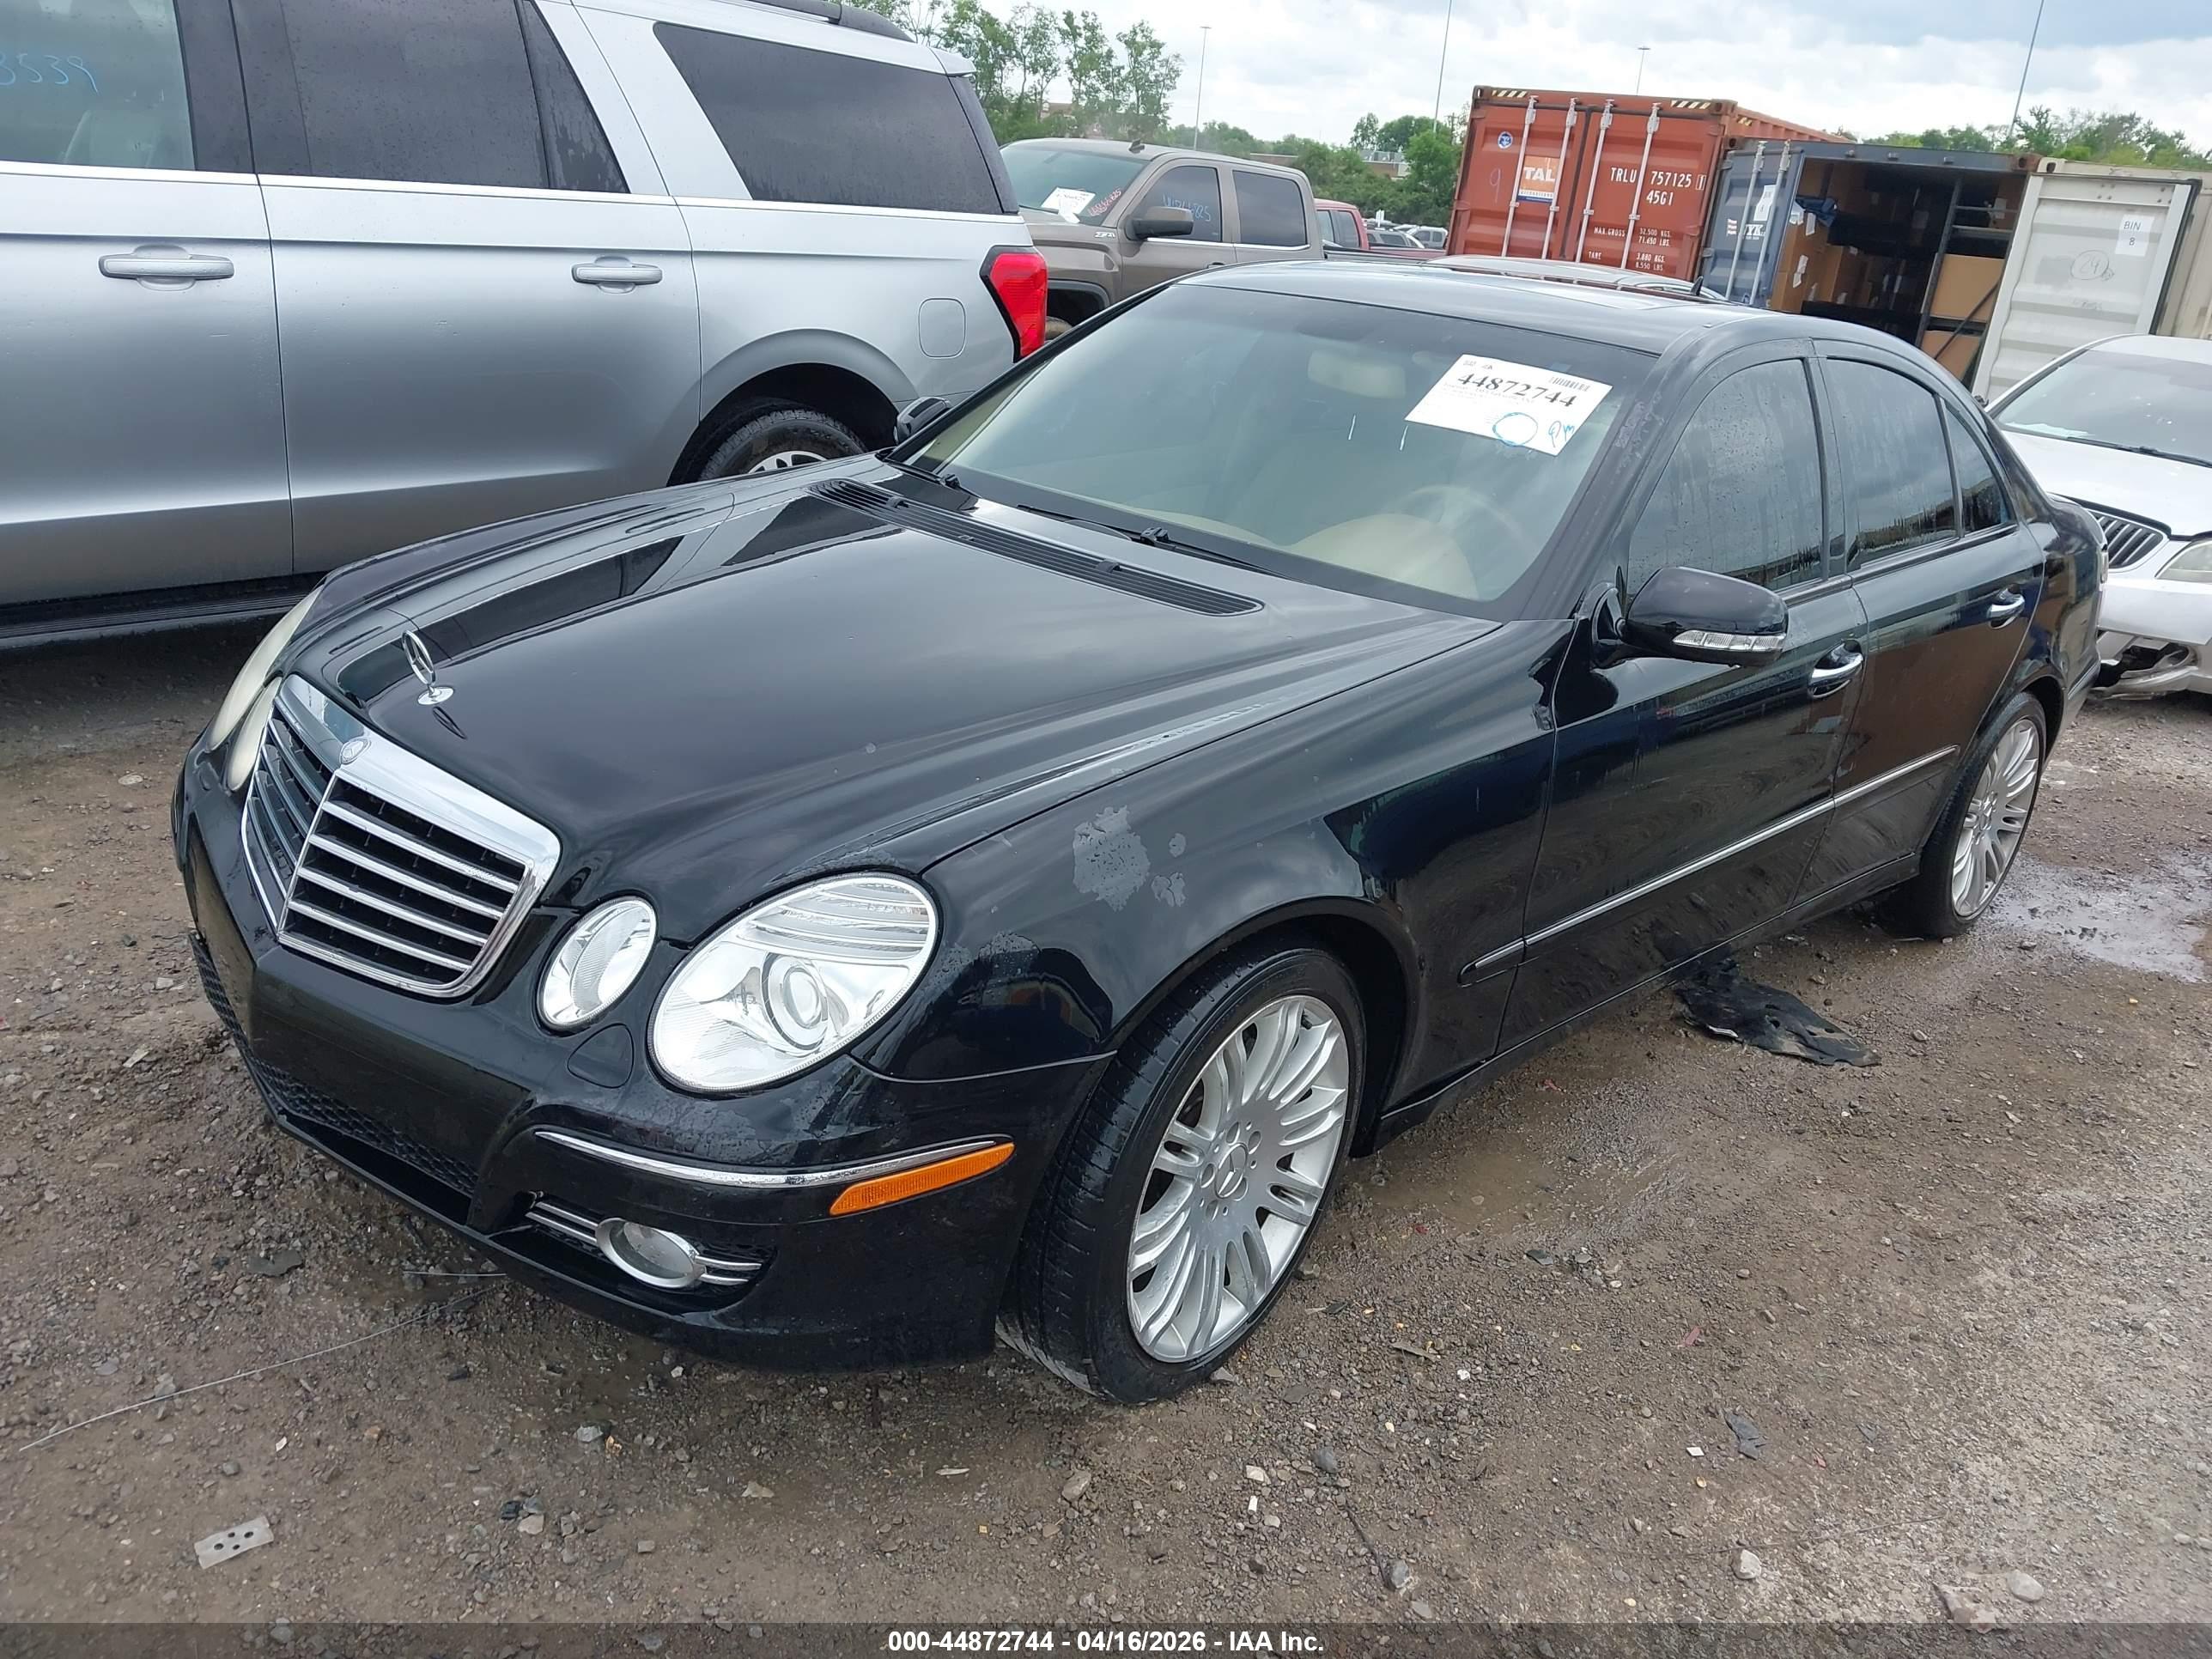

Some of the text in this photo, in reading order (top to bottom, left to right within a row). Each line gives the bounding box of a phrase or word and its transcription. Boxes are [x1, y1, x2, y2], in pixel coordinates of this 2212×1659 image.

[1523, 166, 1555, 182] TAL
[1611, 167, 1637, 183] TRLU
[1651, 171, 1692, 187] 757125
[1647, 190, 1674, 205] 45G1
[2124, 221, 2142, 230] BIN
[2129, 236, 2136, 246] 8
[1589, 251, 1601, 260] TARE
[1457, 373, 1577, 407] 44872744
